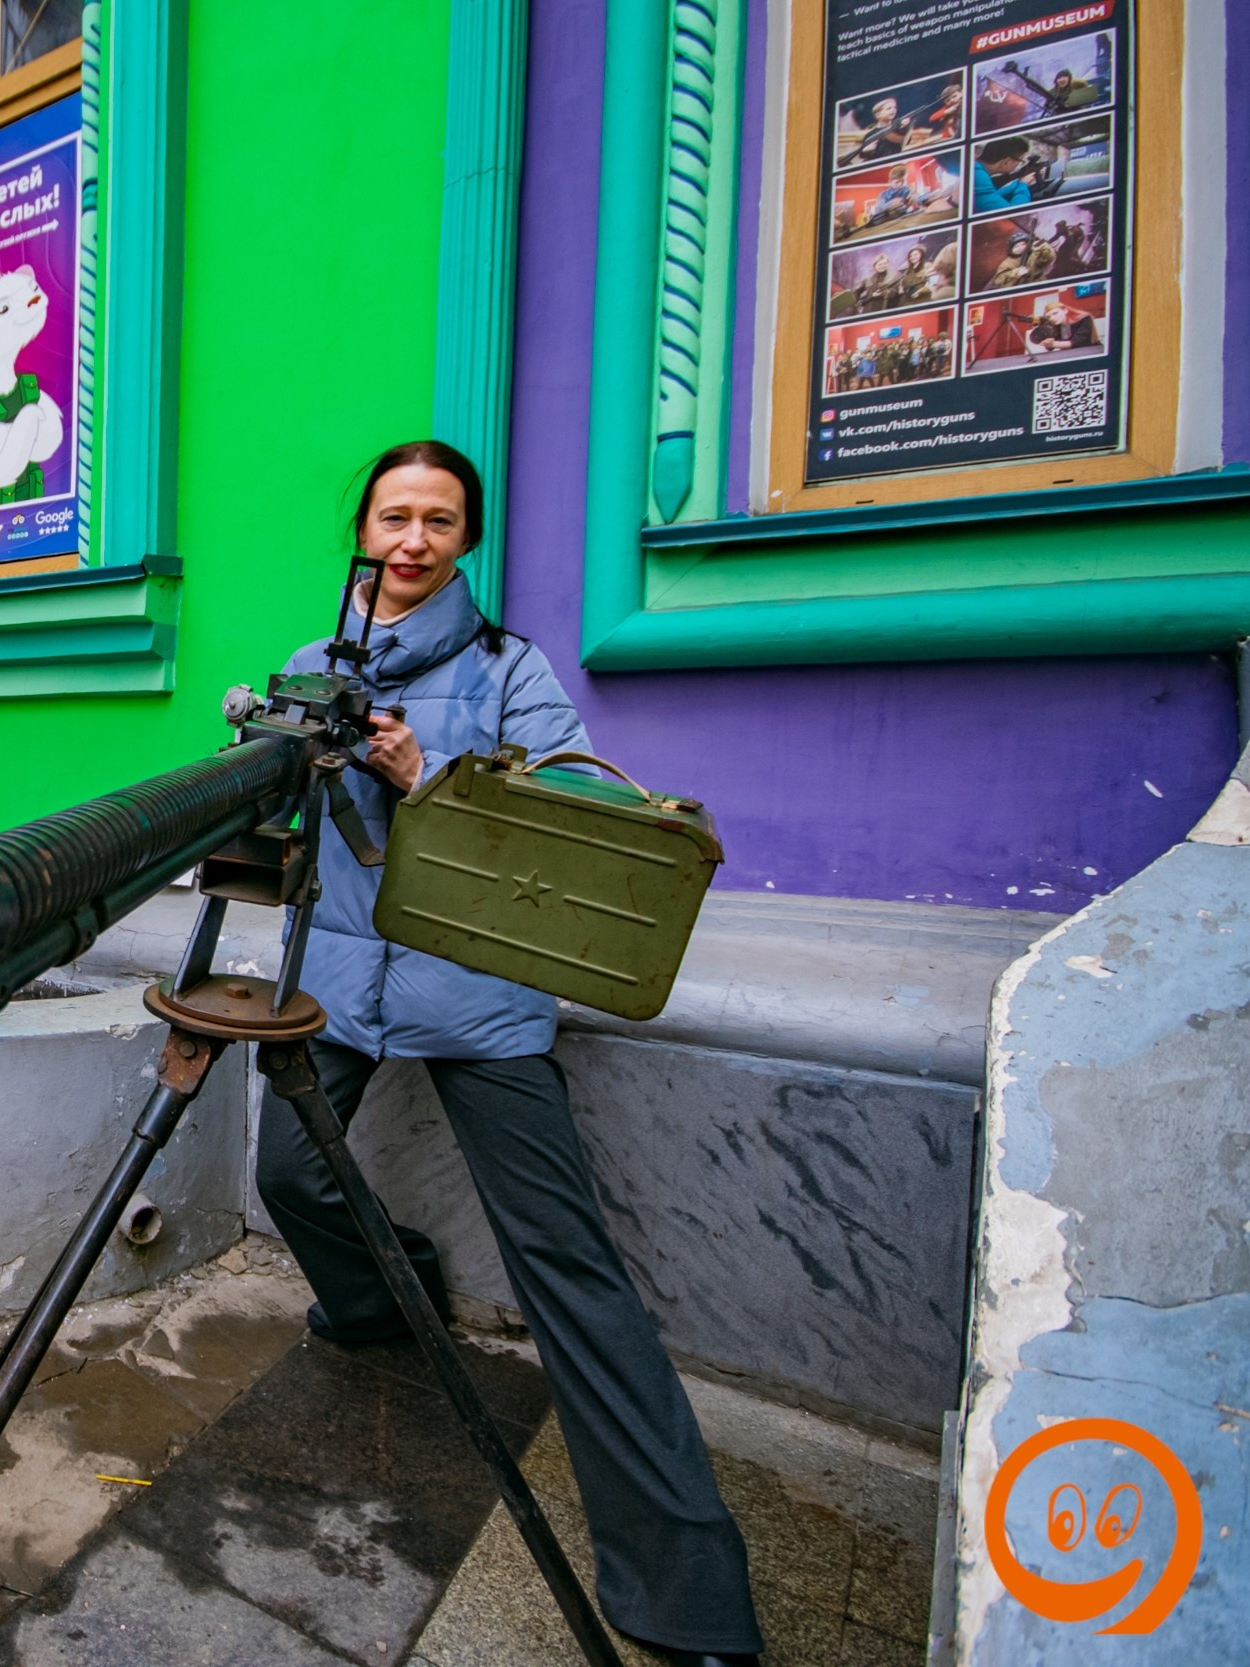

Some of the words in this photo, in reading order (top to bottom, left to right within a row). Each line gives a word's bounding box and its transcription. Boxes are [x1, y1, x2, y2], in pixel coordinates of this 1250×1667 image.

[838, 27, 863, 42] Want
[865, 17, 896, 34] more?
[898, 12, 916, 24] We
[918, 6, 936, 19] will
[938, 1, 960, 13] take
[854, 0, 880, 16] Want
[837, 38, 863, 53] teach
[865, 29, 896, 45] basics
[895, 25, 908, 37] of
[910, 15, 951, 32] weapon
[953, 0, 1017, 20] manipulatio
[837, 44, 872, 63] tactical
[872, 33, 920, 53] medicine
[921, 26, 941, 39] and
[943, 19, 972, 33] many
[973, 8, 1005, 24] more!
[975, 4, 1106, 50] #GUNMUSEUM
[839, 398, 924, 421] gunmuseum
[838, 411, 976, 438] vk.com/historyguns
[1045, 431, 1104, 443] historyguns.ru
[837, 426, 1025, 458] facebook.com/historyguns
[35, 507, 74, 526] Google
